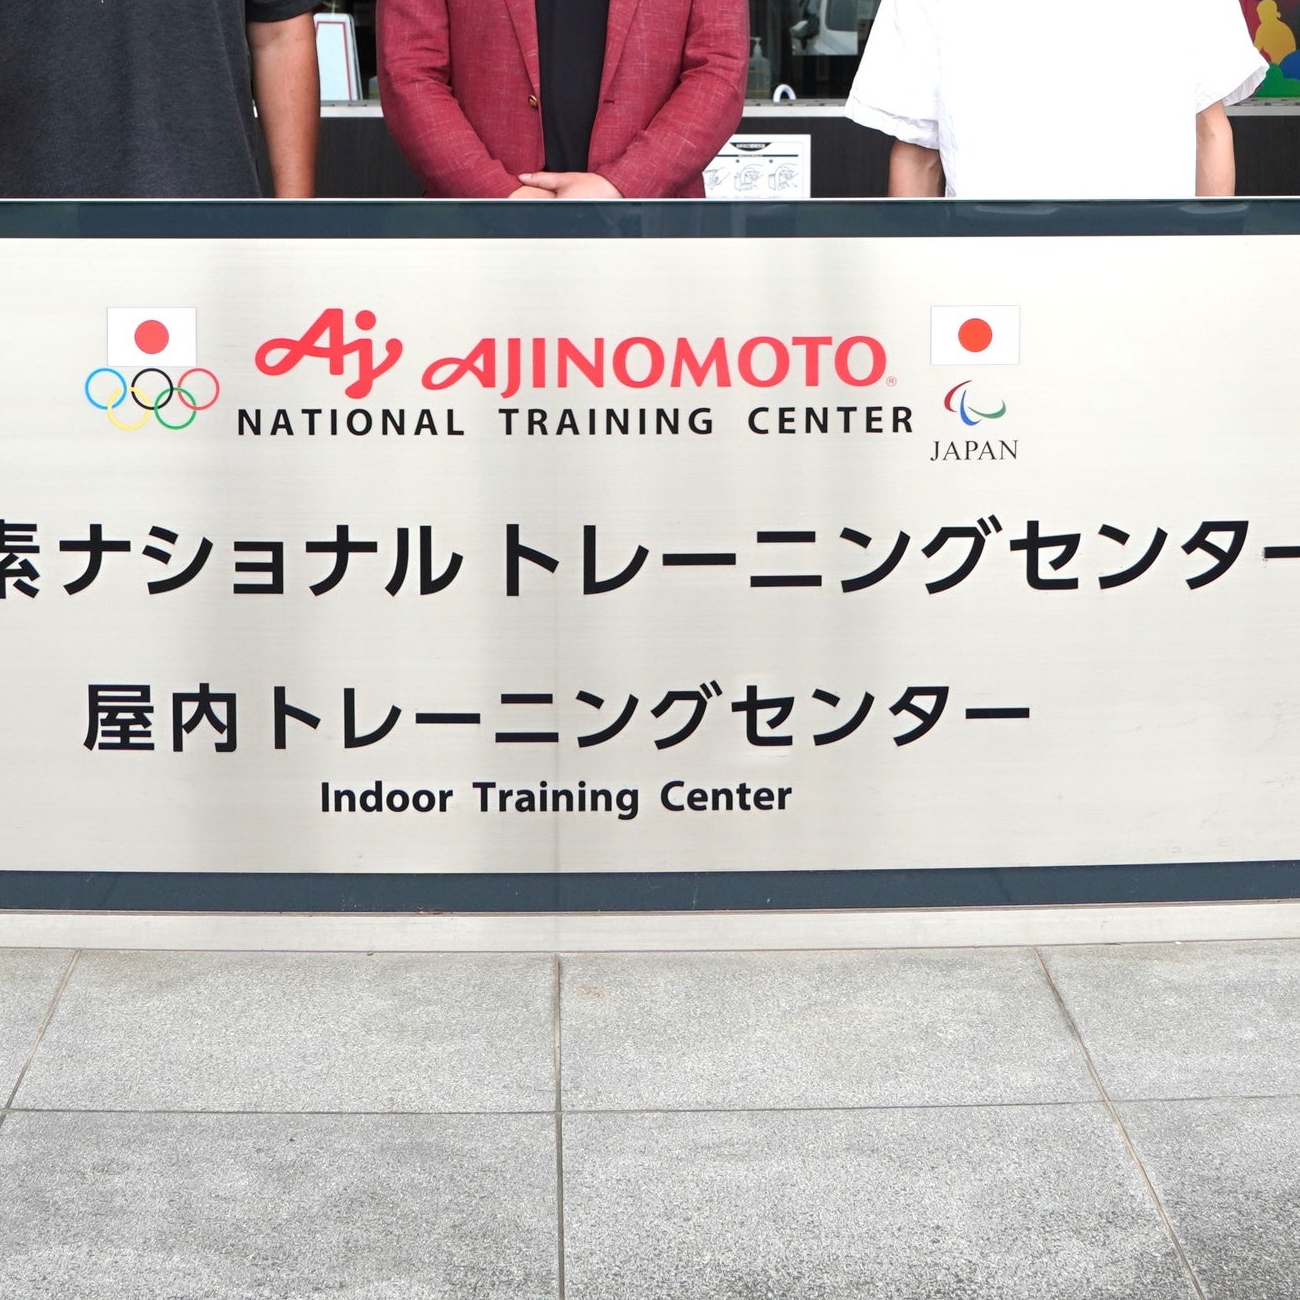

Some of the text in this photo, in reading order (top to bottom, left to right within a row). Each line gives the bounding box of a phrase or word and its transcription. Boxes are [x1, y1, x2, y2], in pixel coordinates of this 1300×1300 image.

[421, 335, 887, 399] AJINOMOTO
[238, 406, 914, 436] NATIONAL TRAINING CENTER
[930, 440, 1018, 461] JAPAN
[83, 679, 1030, 753] 屋内トレーニングセンター
[321, 780, 793, 821] Indoor Training Center
